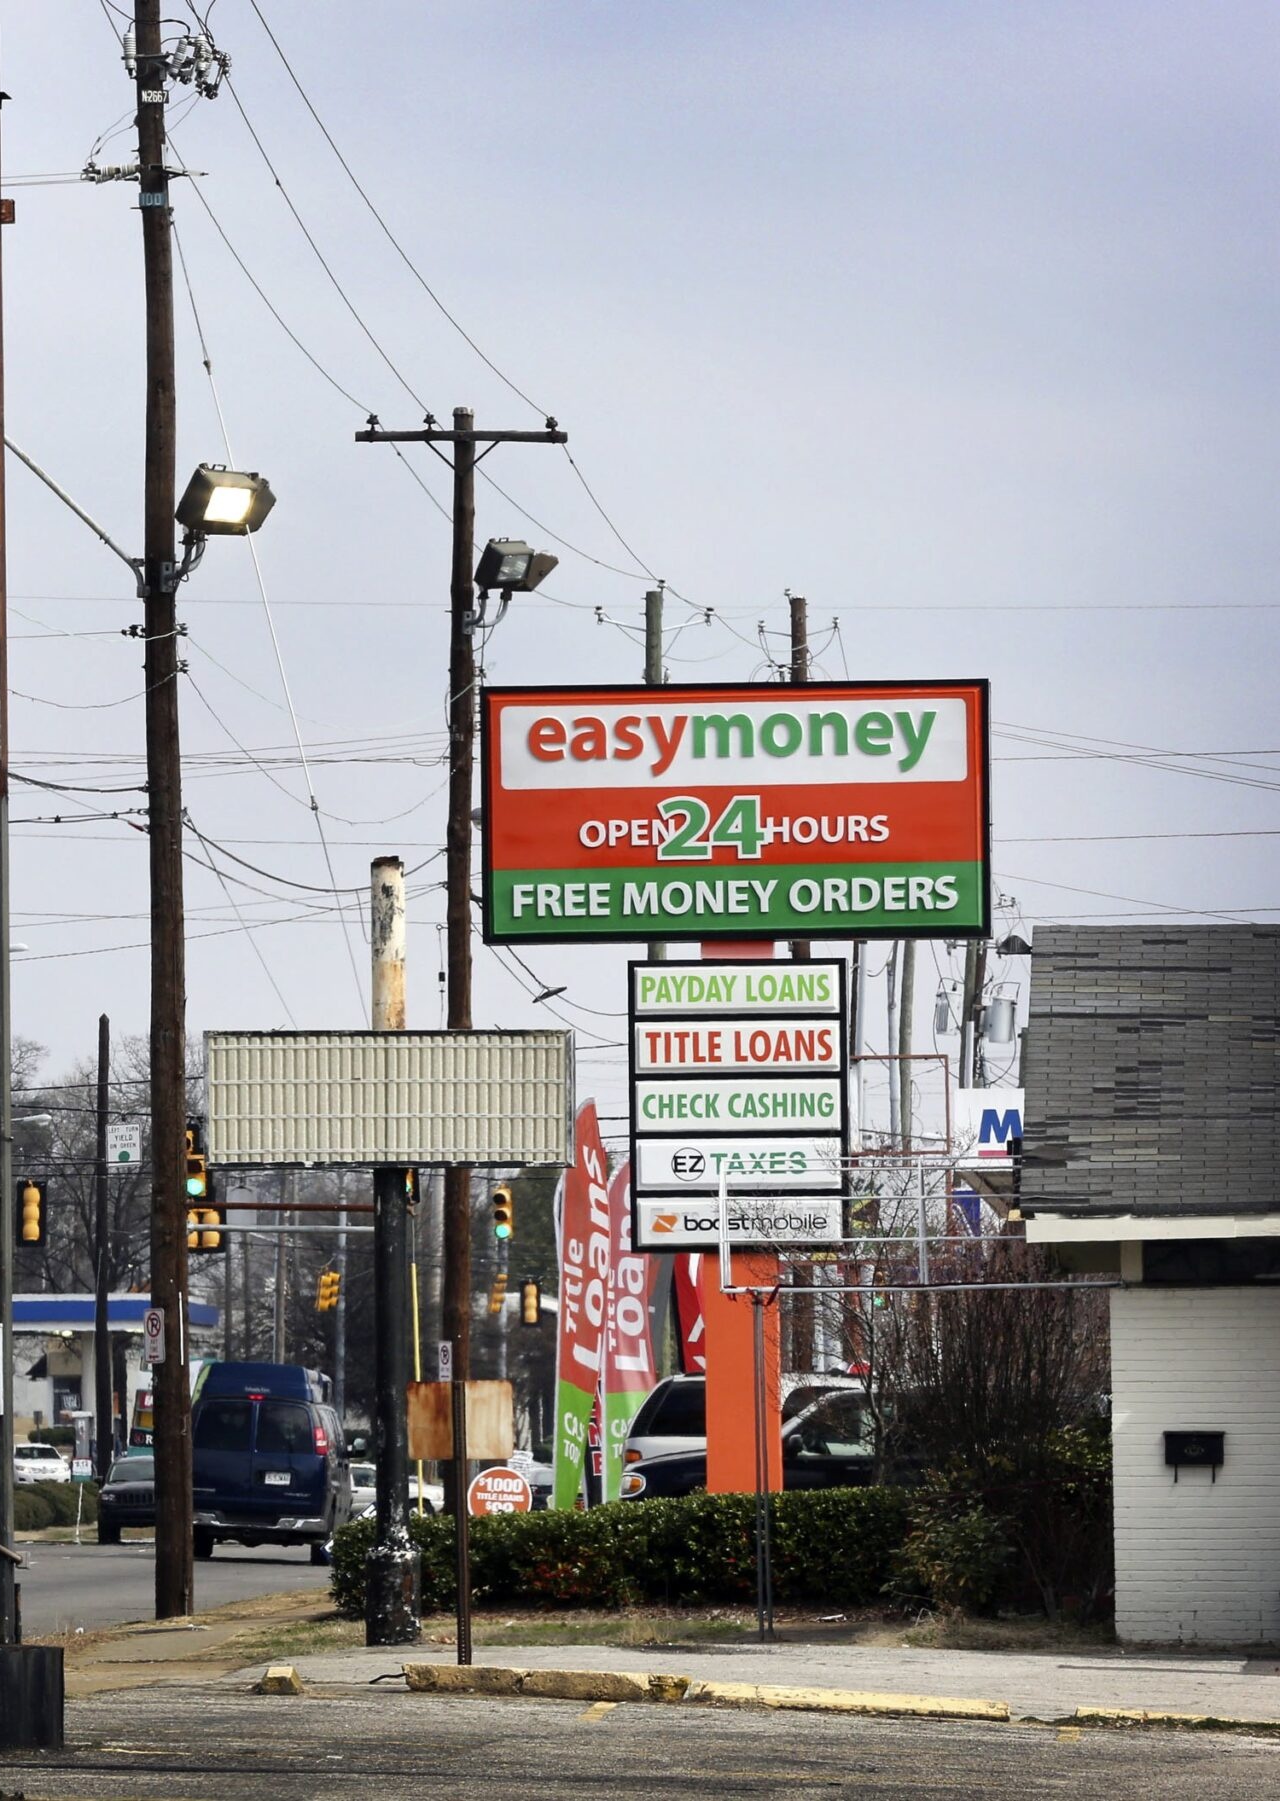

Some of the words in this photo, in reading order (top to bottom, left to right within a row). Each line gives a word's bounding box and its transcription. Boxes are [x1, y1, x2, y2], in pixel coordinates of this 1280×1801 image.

[528, 709, 937, 777] easymoney
[579, 820, 676, 847] OPEN
[657, 795, 766, 860] 24
[767, 815, 889, 843] HOURS
[513, 884, 611, 918] FREE
[623, 879, 777, 916] MONEY
[789, 875, 958, 911] ORDERS
[641, 975, 738, 1003] PAYDAY
[746, 974, 830, 1001] LOANS
[646, 1031, 721, 1063] TITLE
[734, 1029, 833, 1061] LOANS
[642, 1093, 720, 1119] CHECK
[728, 1092, 834, 1118] CASHING
[674, 1155, 703, 1173] EZ
[710, 1151, 807, 1174] TAXES
[573, 1145, 609, 1372] Loans
[564, 1239, 583, 1333] Title
